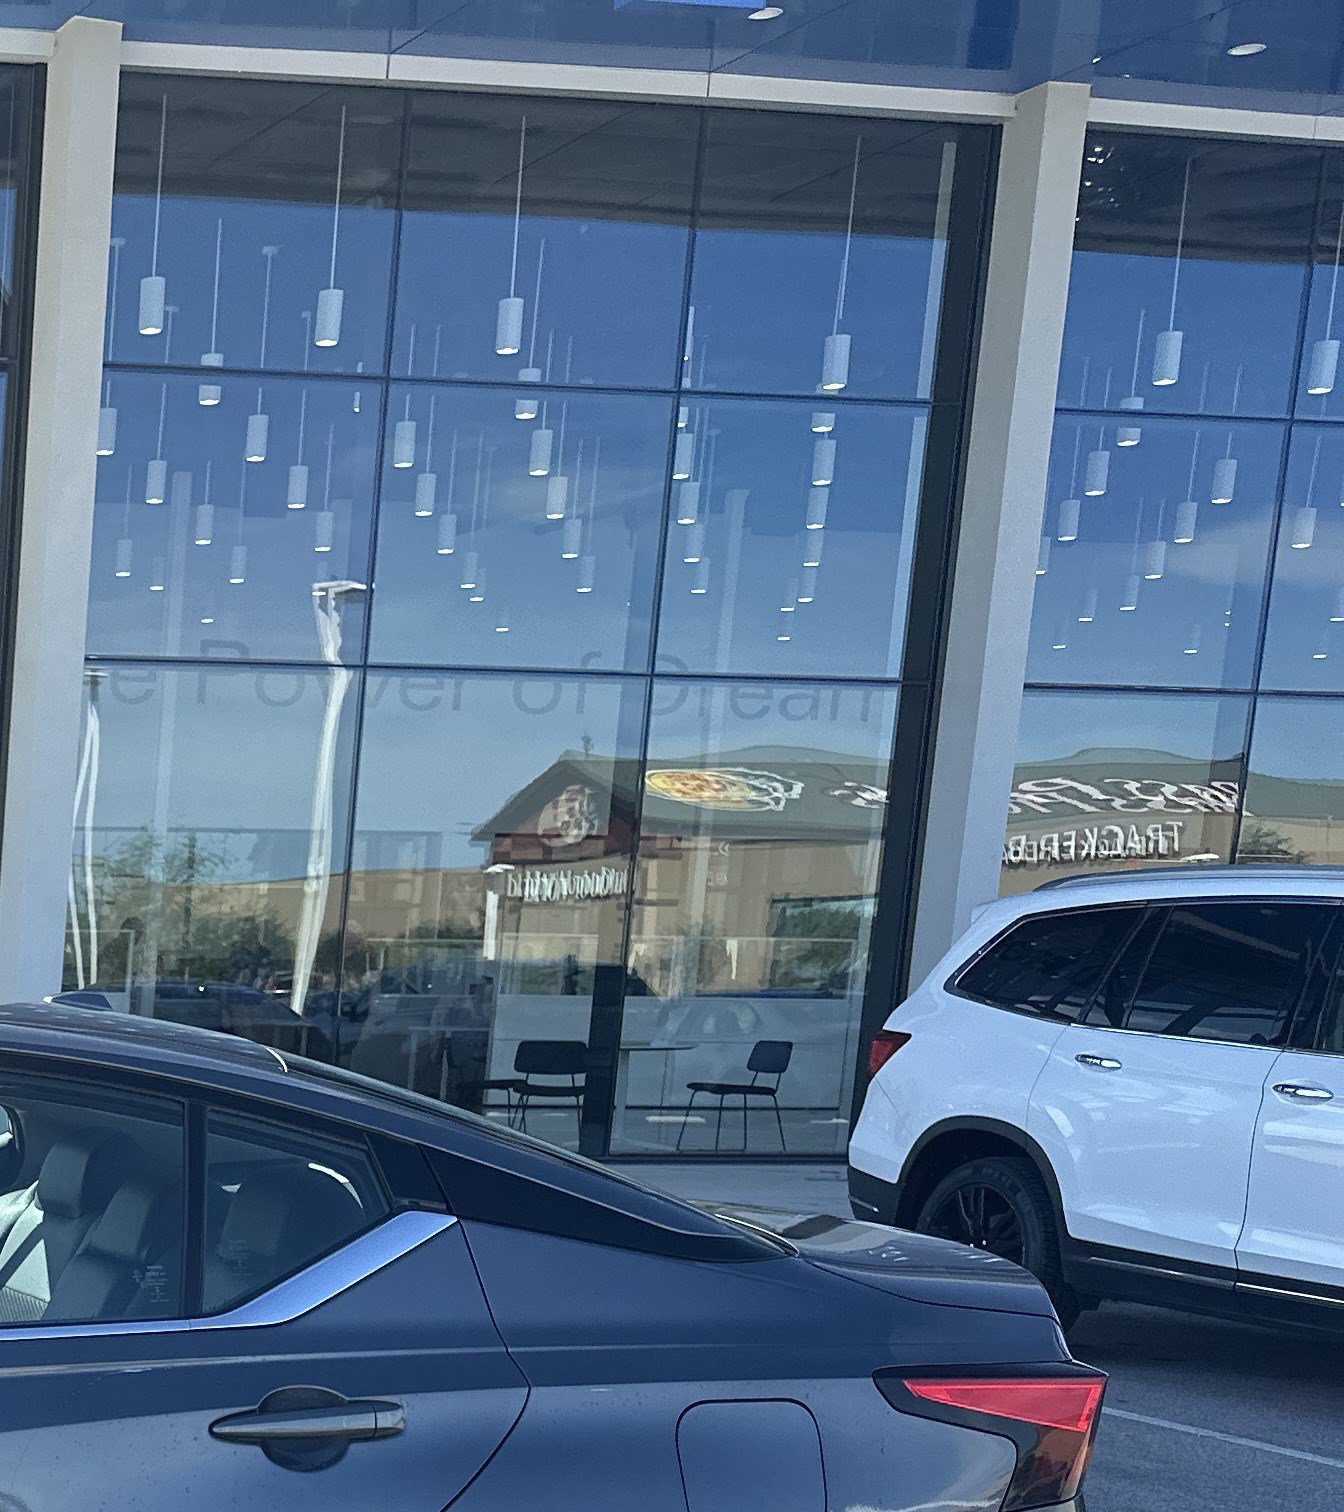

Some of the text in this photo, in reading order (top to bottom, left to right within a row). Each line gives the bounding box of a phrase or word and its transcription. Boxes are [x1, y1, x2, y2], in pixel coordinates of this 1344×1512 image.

[197, 638, 466, 713] Power
[513, 651, 603, 716] of
[648, 653, 880, 724] Dream
